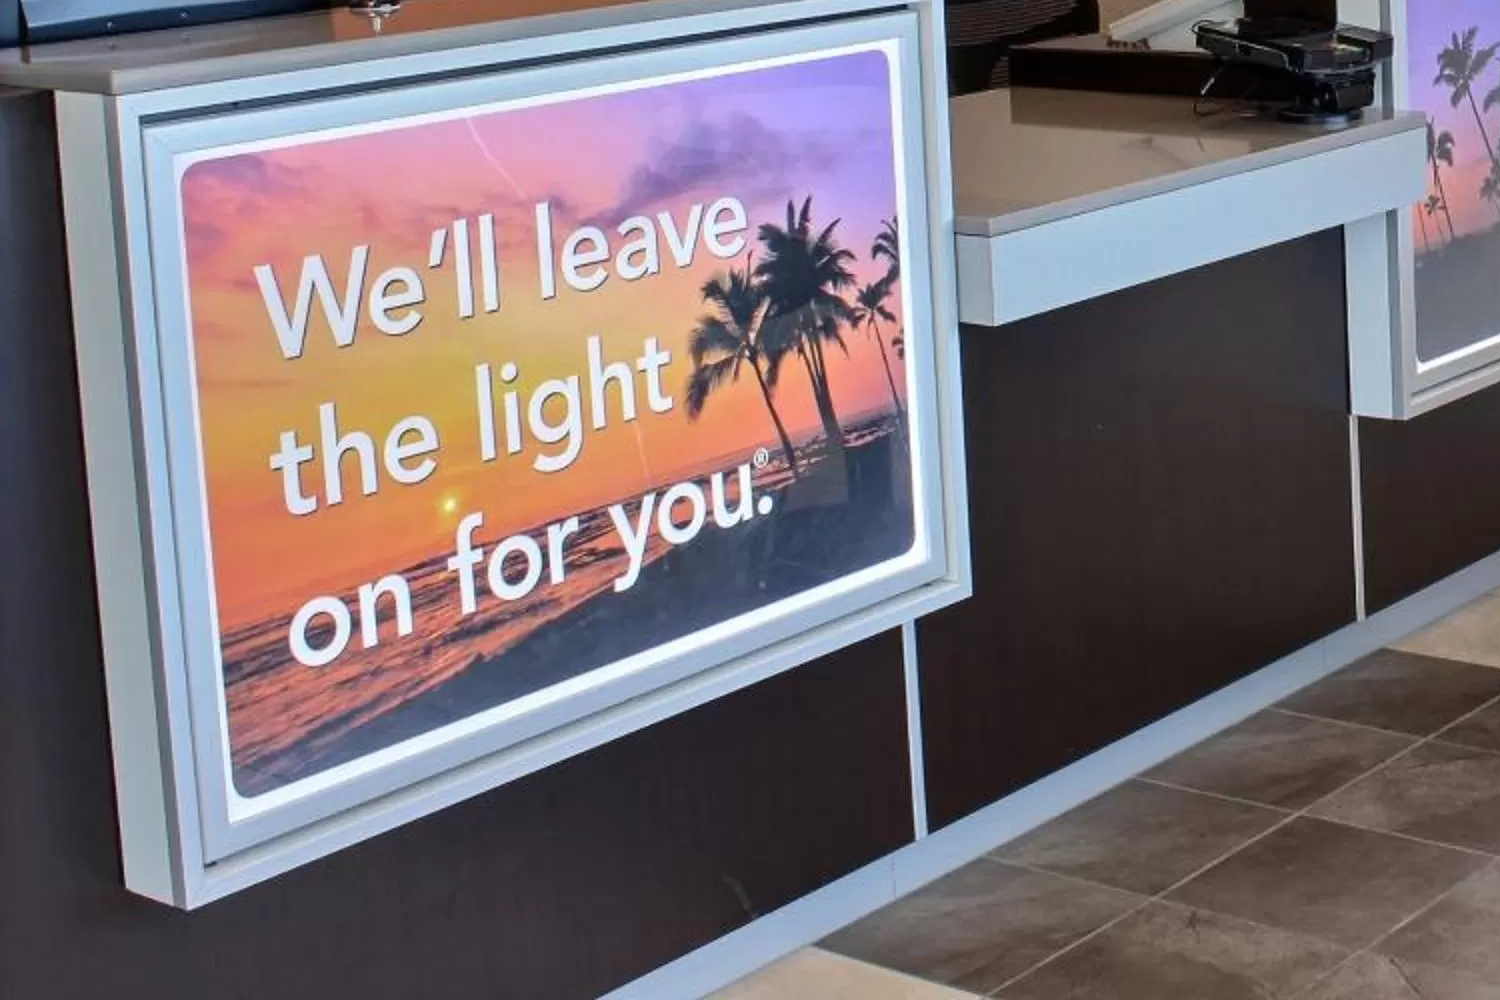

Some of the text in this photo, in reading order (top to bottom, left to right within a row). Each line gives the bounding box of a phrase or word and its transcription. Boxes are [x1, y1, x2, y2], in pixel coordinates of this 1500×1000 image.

[253, 197, 749, 360] We'll leave
[269, 336, 673, 516] the light
[288, 571, 413, 668] on
[447, 513, 579, 615] for
